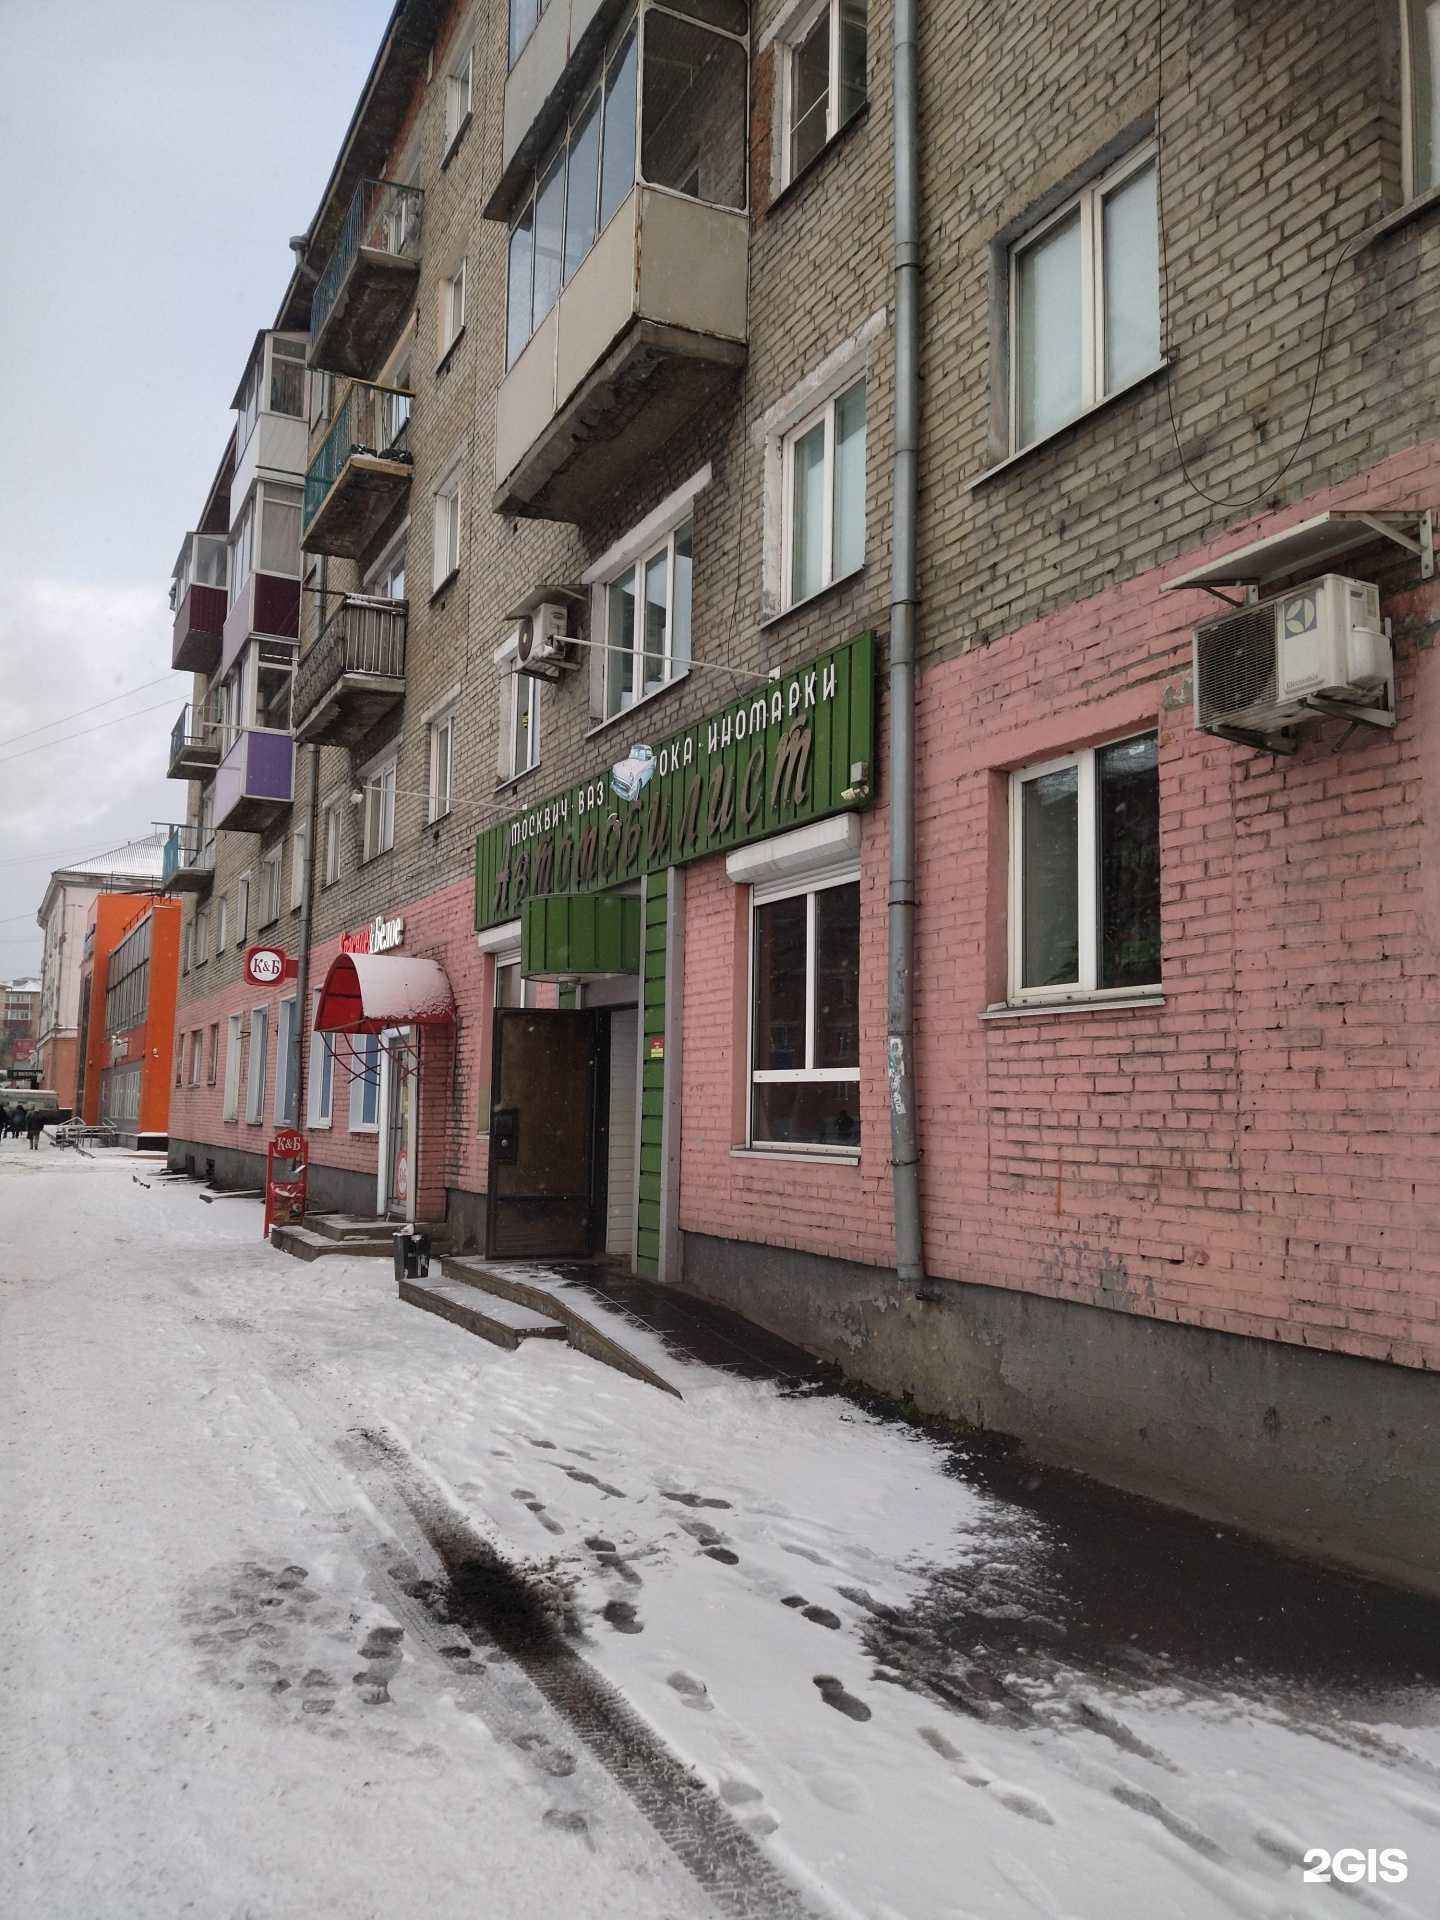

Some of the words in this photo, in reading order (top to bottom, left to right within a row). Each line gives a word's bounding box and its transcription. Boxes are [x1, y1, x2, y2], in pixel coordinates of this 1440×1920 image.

[511, 797, 568, 847] МОСКВИЧ
[578, 780, 604, 815] ВАЗ
[659, 736, 693, 777] ОКА
[707, 663, 836, 754] ИНОМАРКИ
[252, 958, 280, 975] К&Б
[277, 1136, 301, 1151] К&Б
